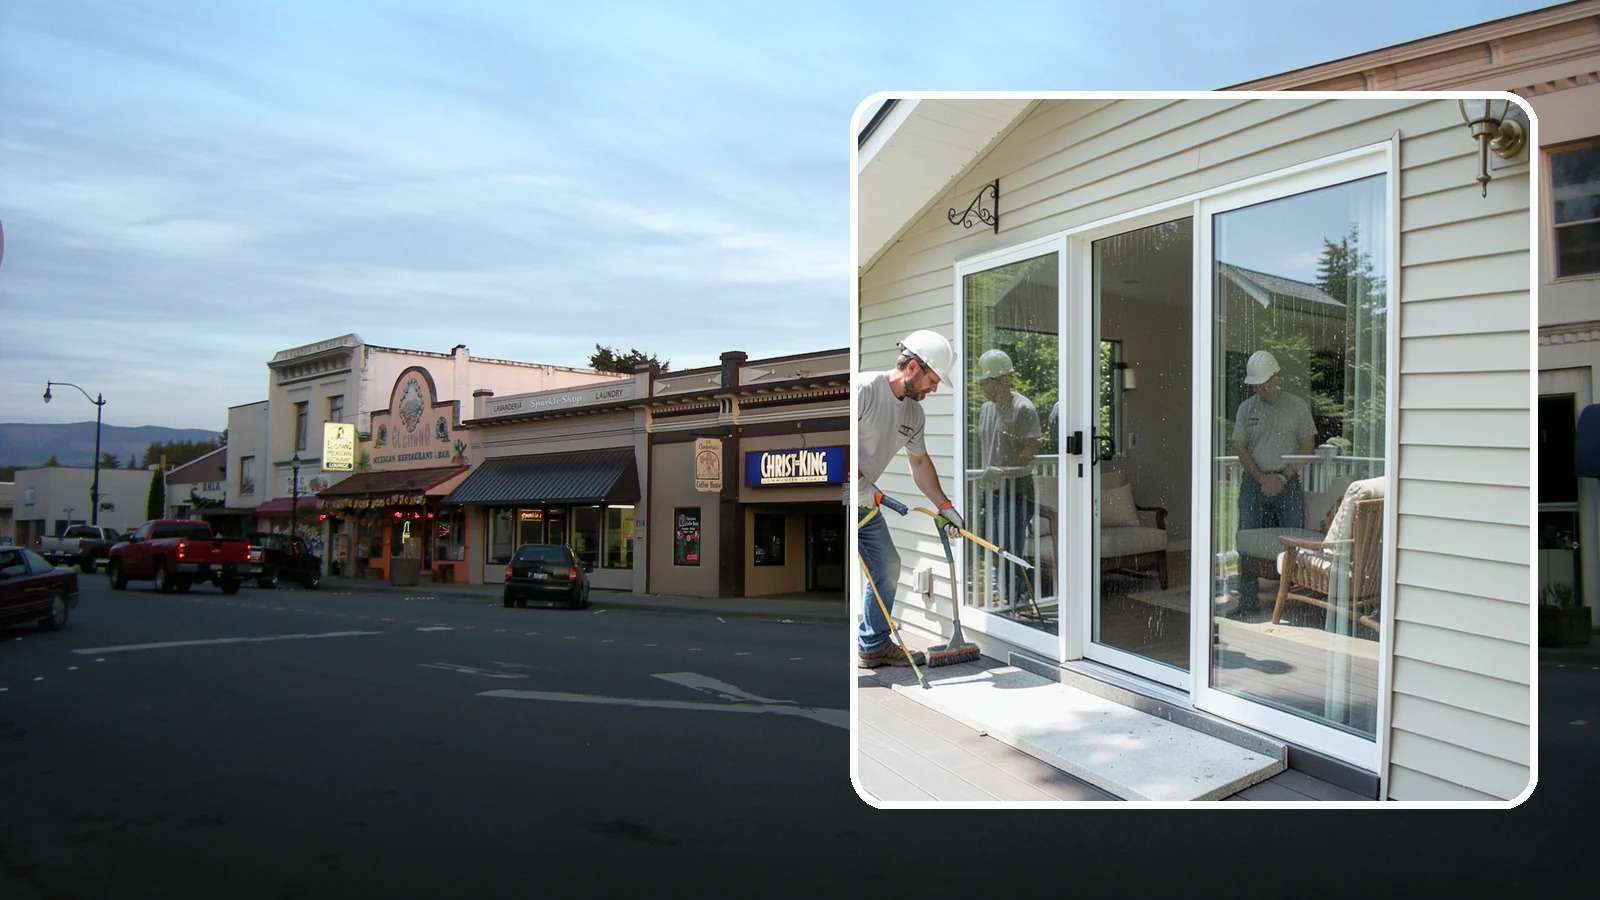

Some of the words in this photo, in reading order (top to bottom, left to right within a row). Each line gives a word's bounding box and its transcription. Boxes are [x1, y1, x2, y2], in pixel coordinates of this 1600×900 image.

[595, 389, 623, 399] LAUNDRY
[493, 402, 523, 413] LAVANDERIA
[531, 397, 561, 409] Sparkle
[562, 394, 582, 405] Shop
[373, 455, 396, 463] MEXICAN
[397, 452, 433, 462] RESTAURANT
[438, 450, 449, 459] BAR
[761, 452, 797, 478] CHRIST
[799, 449, 828, 476] KING
[696, 480, 709, 489] Coffee
[710, 480, 722, 489] House
